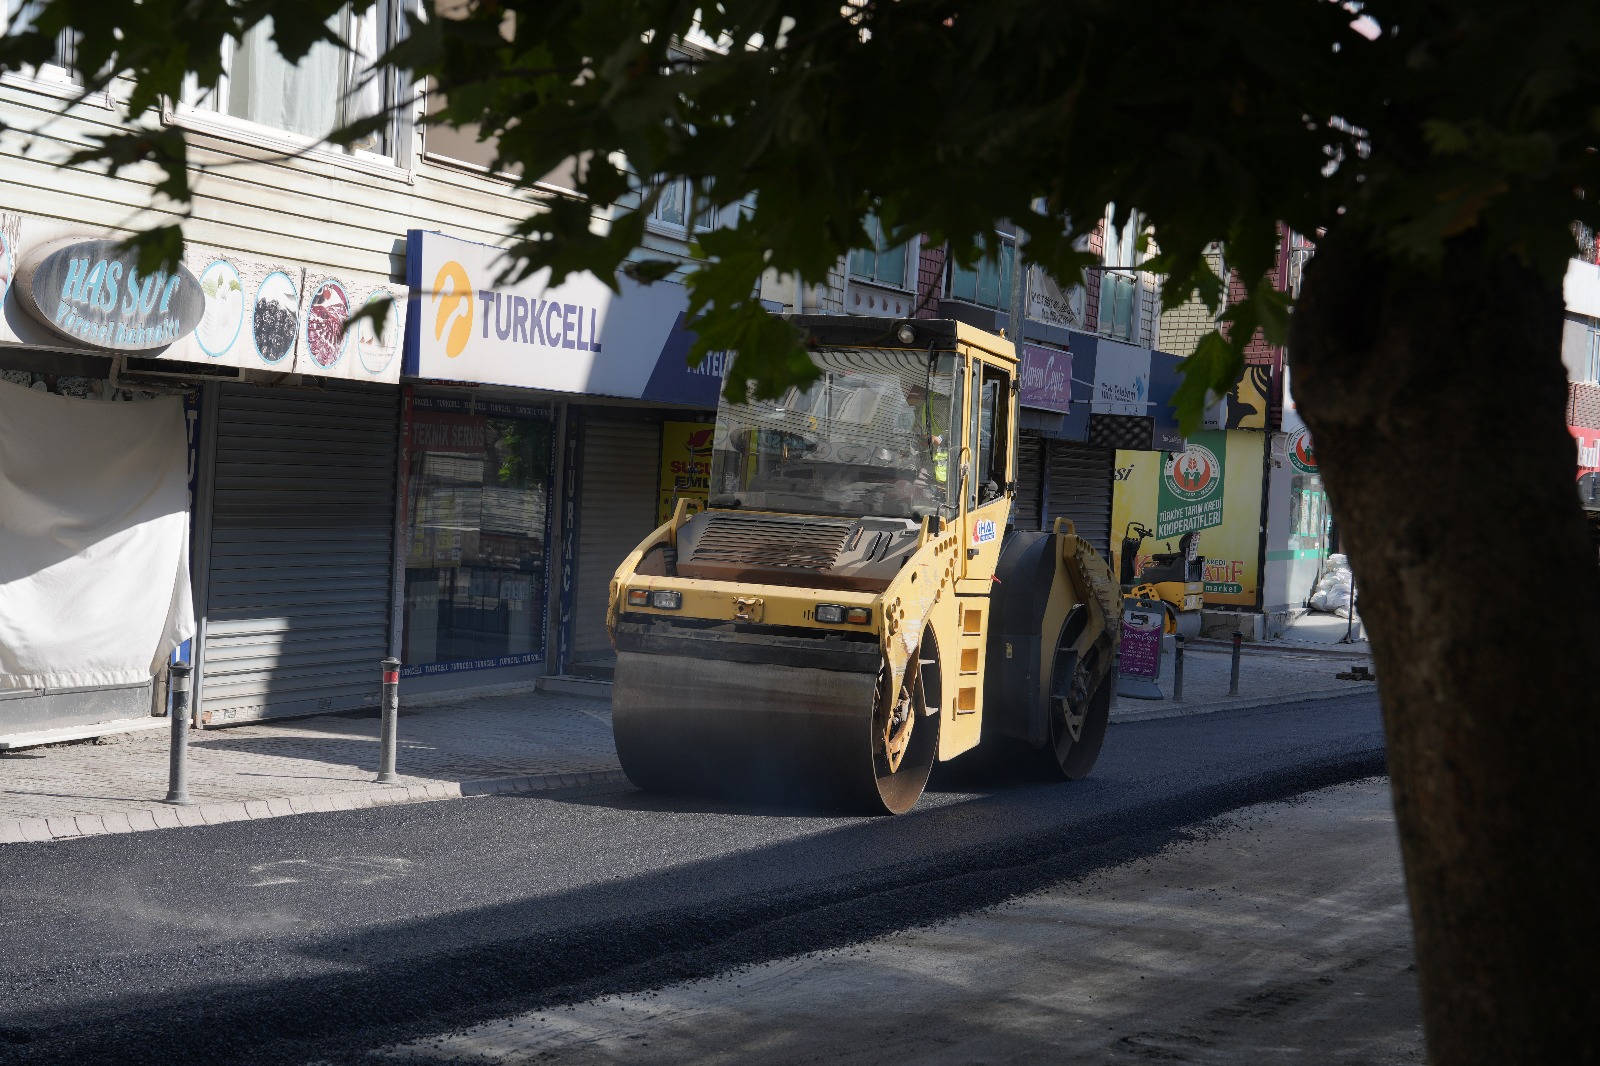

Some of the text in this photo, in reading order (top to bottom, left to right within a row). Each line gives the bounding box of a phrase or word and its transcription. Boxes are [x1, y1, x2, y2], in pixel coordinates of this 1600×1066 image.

[61, 258, 123, 313] HAS
[479, 290, 602, 352] TURKCELL
[412, 418, 485, 447] TEKNİK SERVİS
[1158, 508, 1221, 538] KOOPERATİFLERİ
[1159, 496, 1222, 523] TÜRKİYE TARIM KREDİ
[1205, 584, 1237, 593] market
